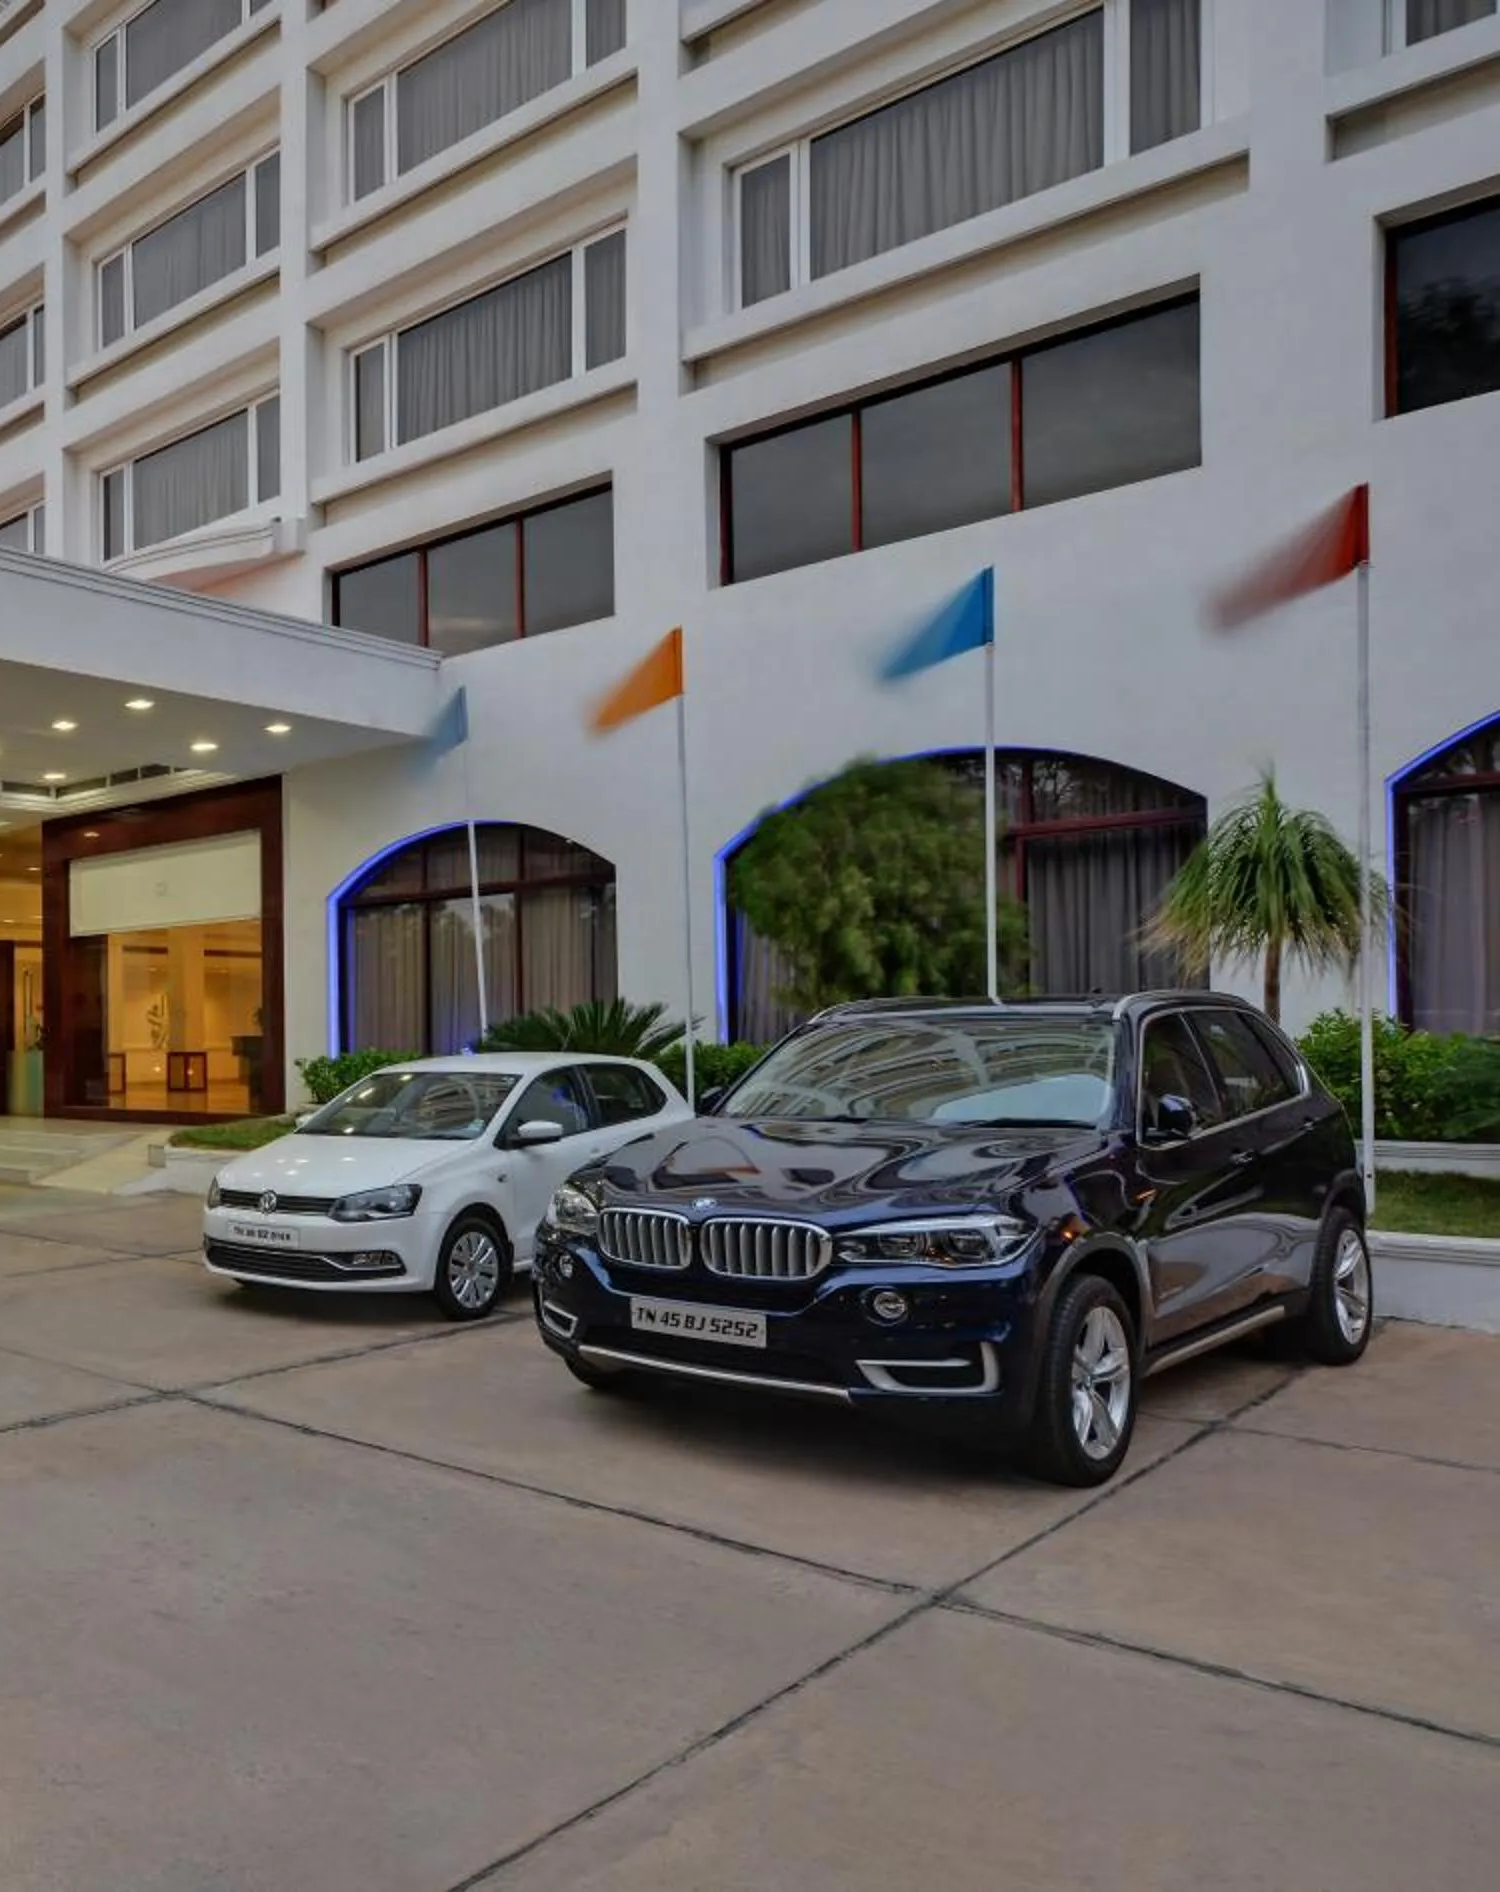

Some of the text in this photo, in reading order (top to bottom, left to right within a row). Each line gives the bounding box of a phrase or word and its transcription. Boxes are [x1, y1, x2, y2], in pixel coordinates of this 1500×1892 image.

[637, 1306, 758, 1339] TN 45 BJ 5252
